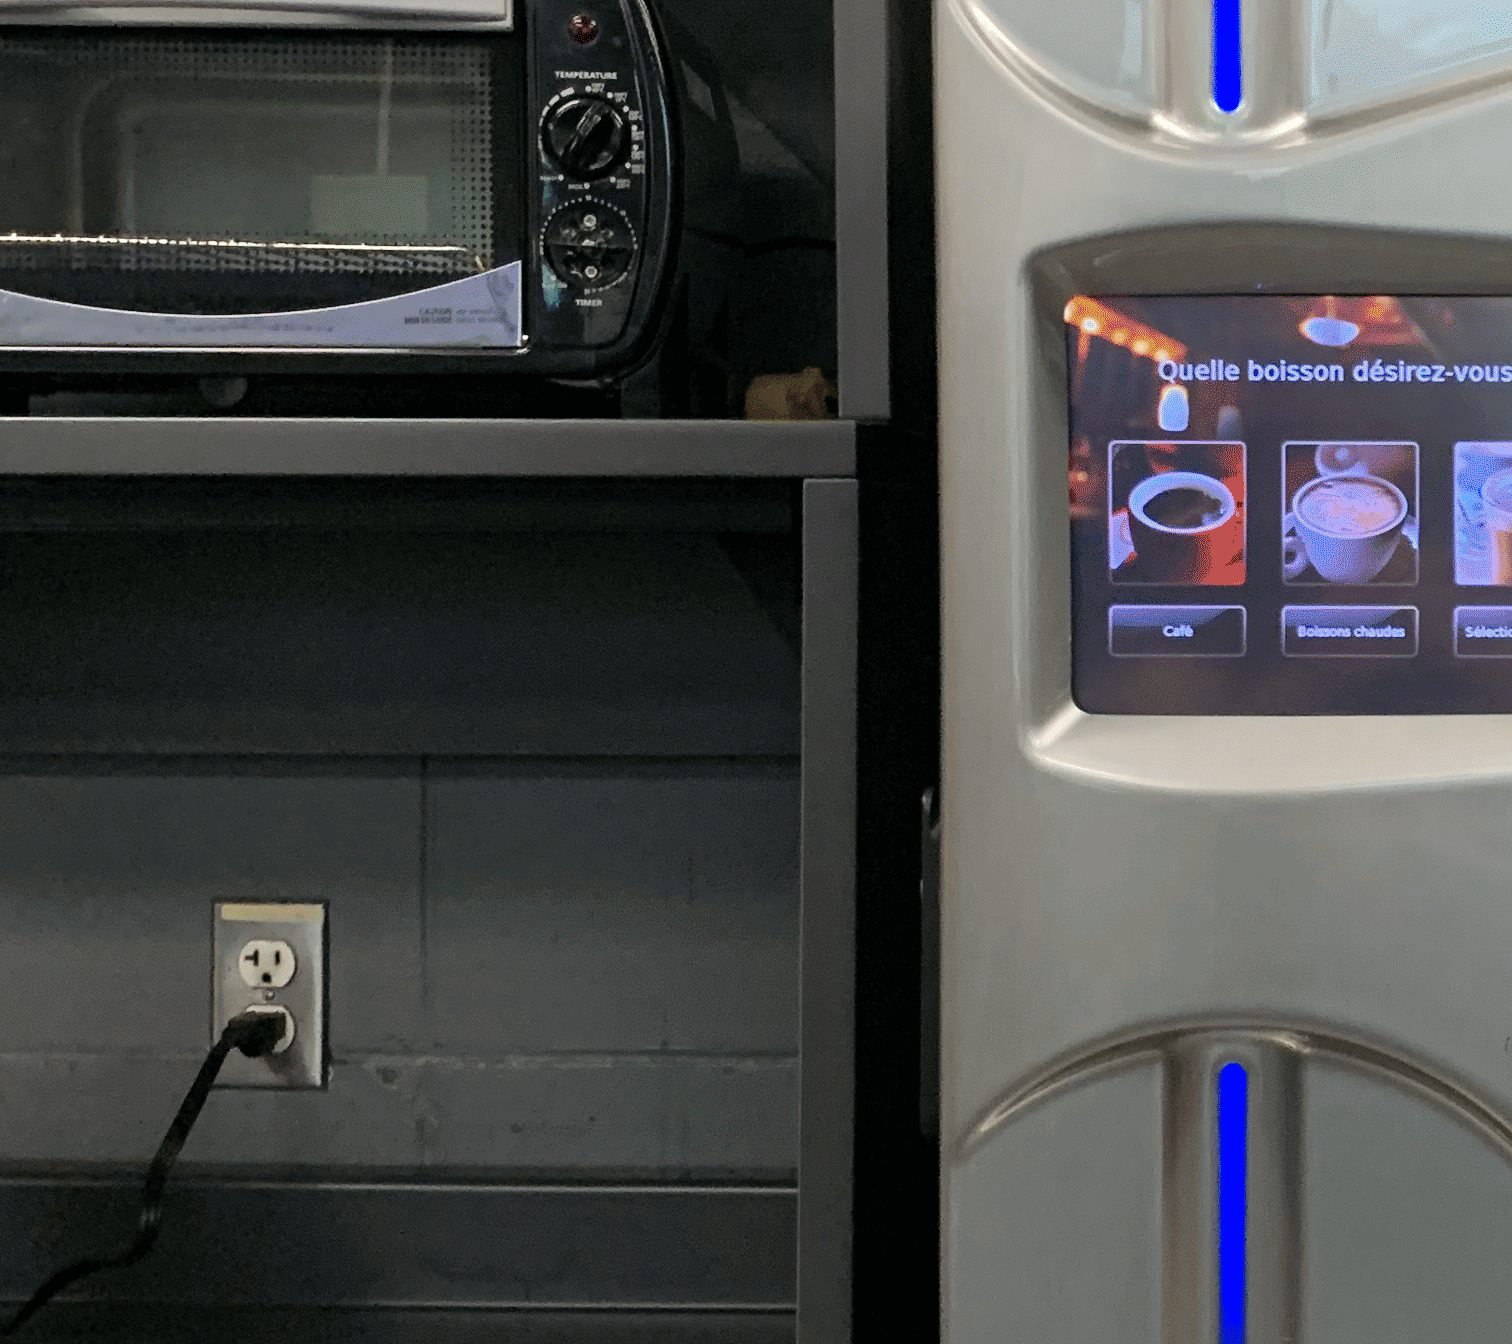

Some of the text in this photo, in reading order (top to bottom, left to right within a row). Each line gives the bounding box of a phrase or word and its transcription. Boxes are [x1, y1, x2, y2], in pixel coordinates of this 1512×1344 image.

[554, 70, 618, 81] TEMPERATURE
[1157, 359, 1240, 383] Quelle
[1247, 359, 1344, 383] boisson
[1162, 623, 1194, 638] Café
[1297, 625, 1406, 639] Boissons chaudes
